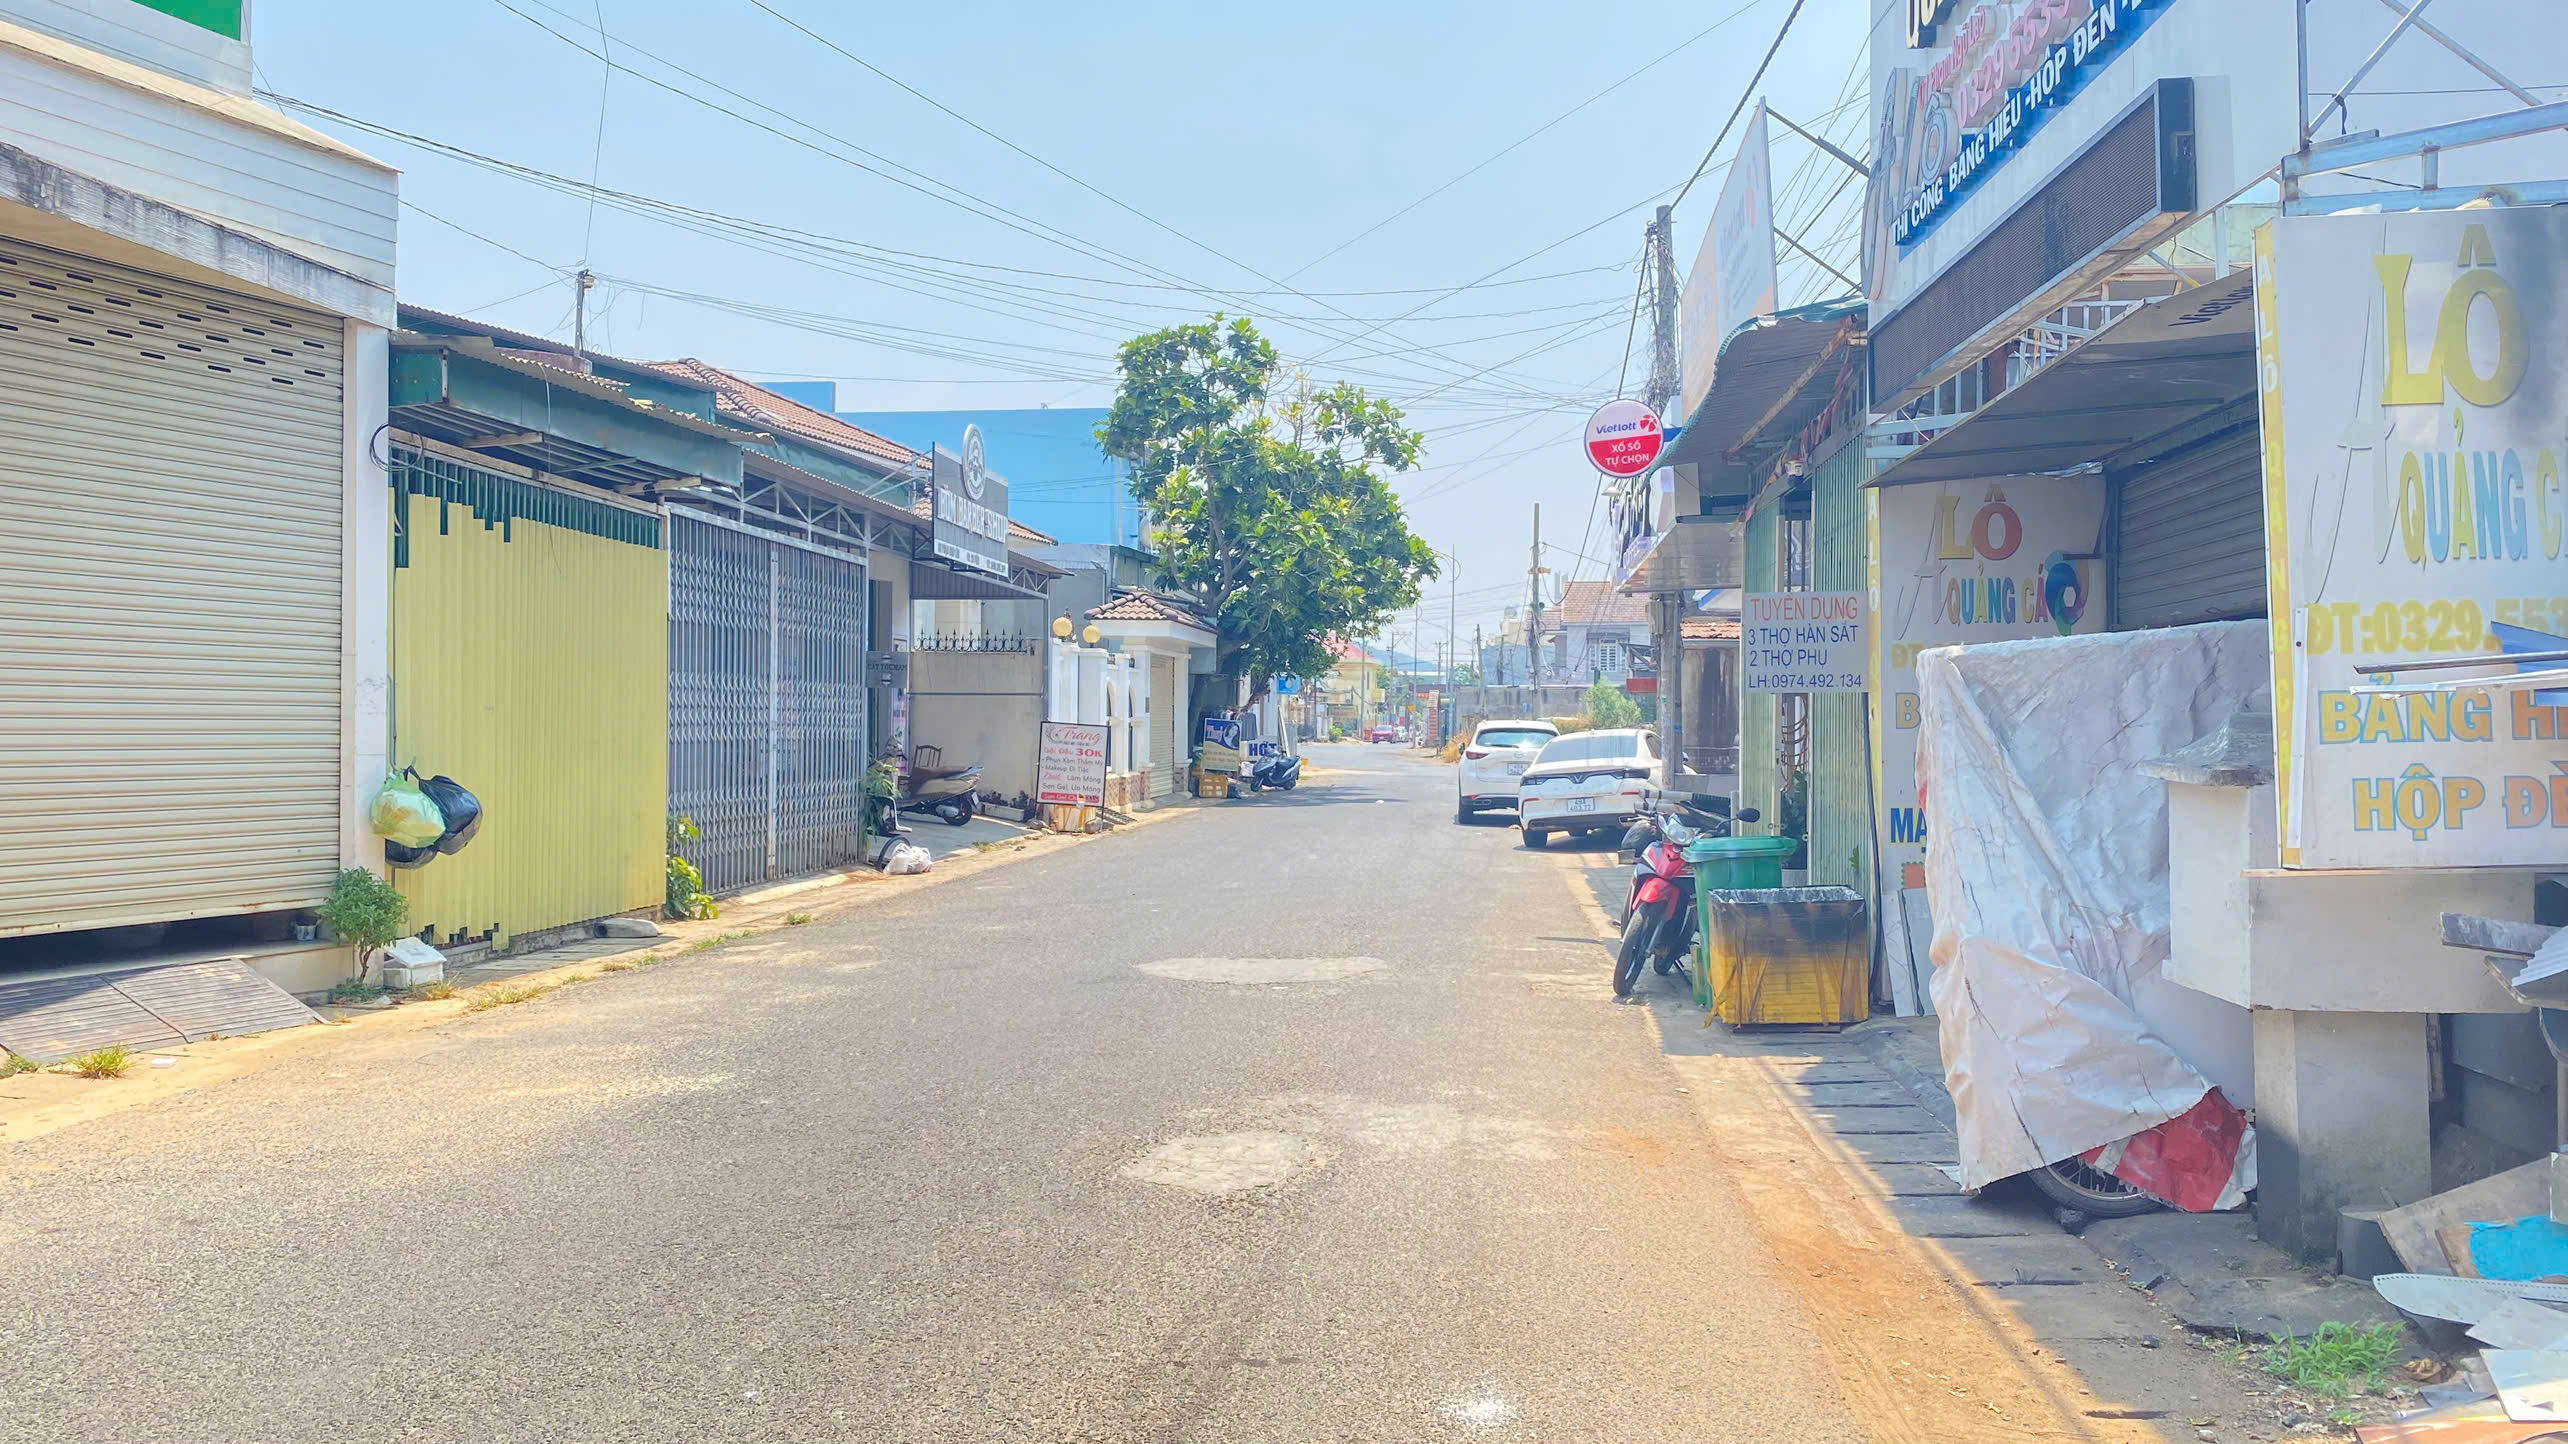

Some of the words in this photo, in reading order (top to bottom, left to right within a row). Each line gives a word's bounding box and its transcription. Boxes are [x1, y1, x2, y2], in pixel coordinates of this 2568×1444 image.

[1891, 208, 1909, 246] THI
[1988, 90, 2022, 154] HIỆU
[1596, 422, 1637, 434] Vietlott
[1628, 440, 1641, 452] SỐ
[1605, 455, 1620, 468] TỰ
[1621, 453, 1650, 465] CHỌN
[2398, 407, 2529, 572] QUẢNG
[1946, 560, 2016, 627] QUẢNG
[1810, 596, 1858, 624] DỤNG
[1748, 628, 1756, 645] 3
[1760, 626, 1793, 648] THỢ
[1796, 623, 1826, 644] HÀN
[1749, 650, 1758, 667] 2
[1761, 649, 1793, 669] THỢ
[1797, 648, 1828, 669] PHỤ
[1748, 673, 1862, 688] LH:0974.492.134
[2319, 671, 2493, 744] BẢNG
[1063, 727, 1102, 746] Trang
[2352, 762, 2487, 842] HỘP
